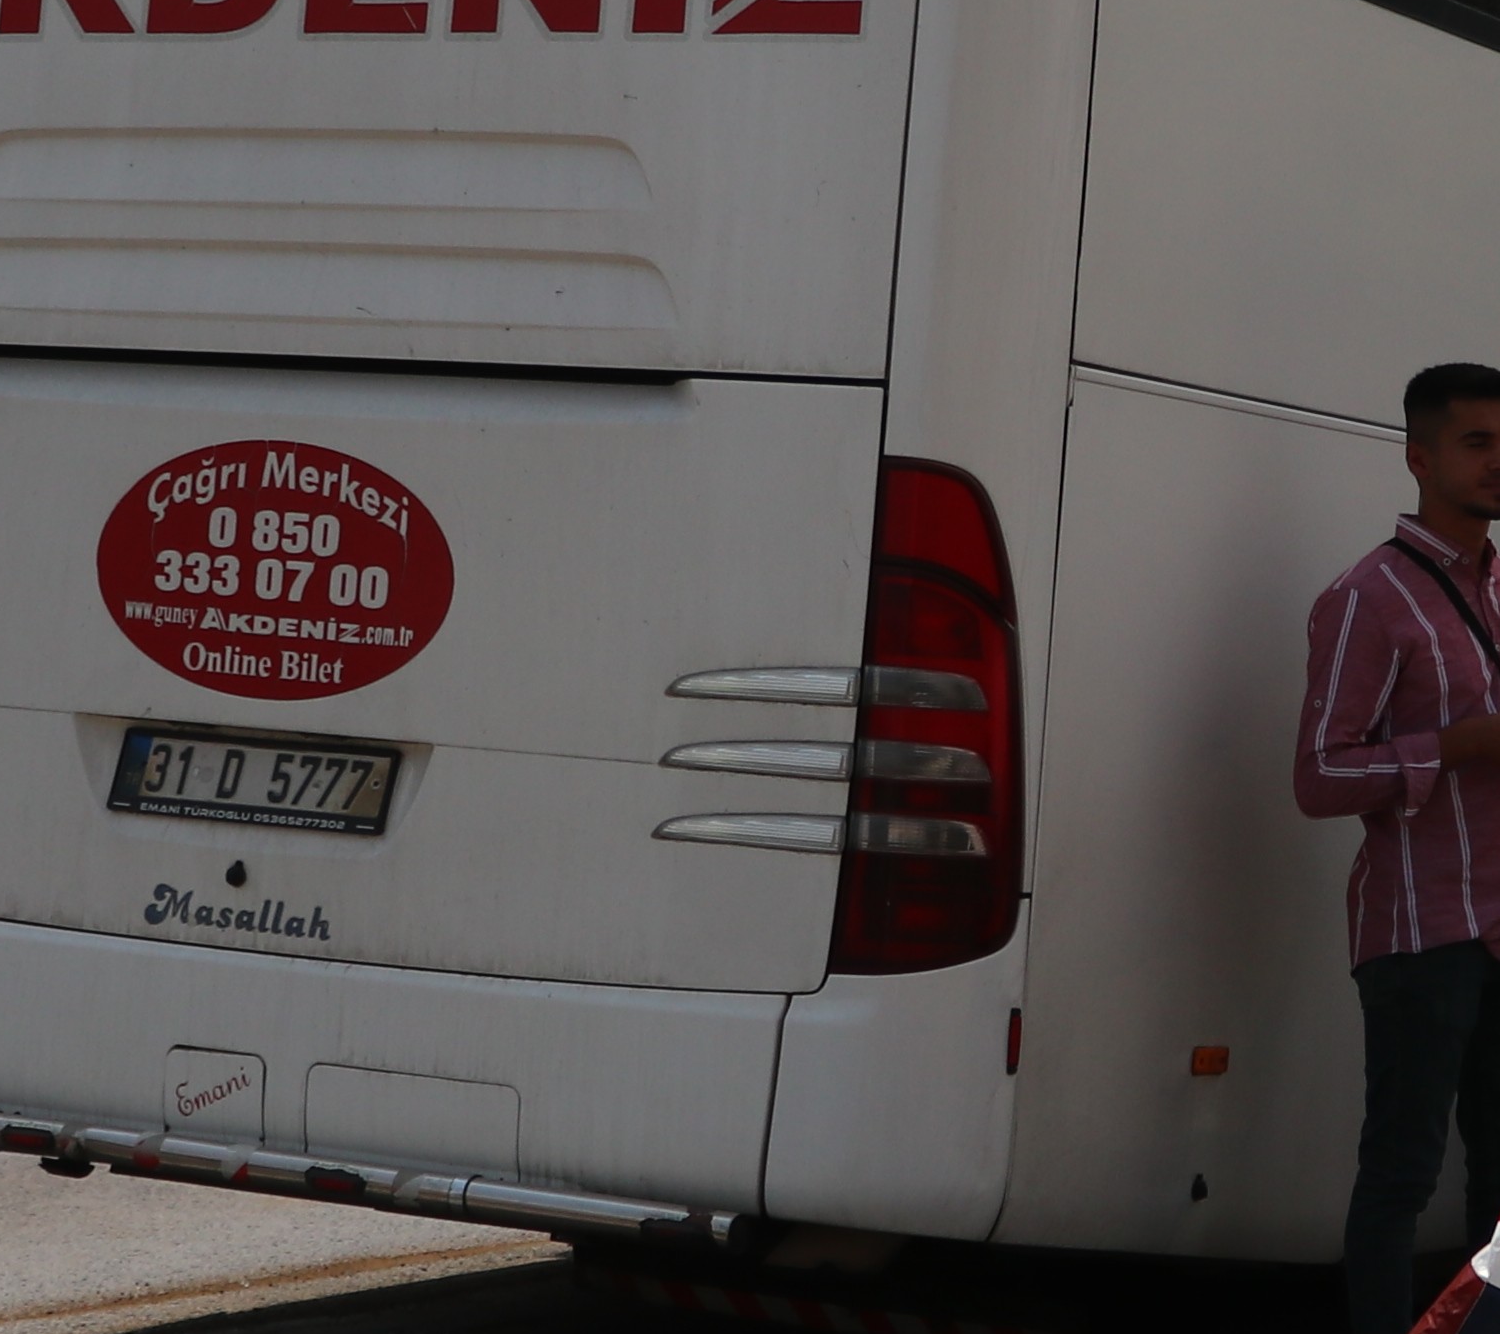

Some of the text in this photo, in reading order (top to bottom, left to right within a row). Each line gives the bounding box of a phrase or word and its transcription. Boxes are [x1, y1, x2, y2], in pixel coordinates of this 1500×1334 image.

[147, 451, 409, 537] Çağrı Merkezi
[208, 506, 340, 557] 0 850
[154, 549, 389, 609] 333 07 00
[183, 642, 344, 684] Online Bilet
[145, 744, 374, 810] 31 D 5777
[175, 1067, 251, 1116] Emani
